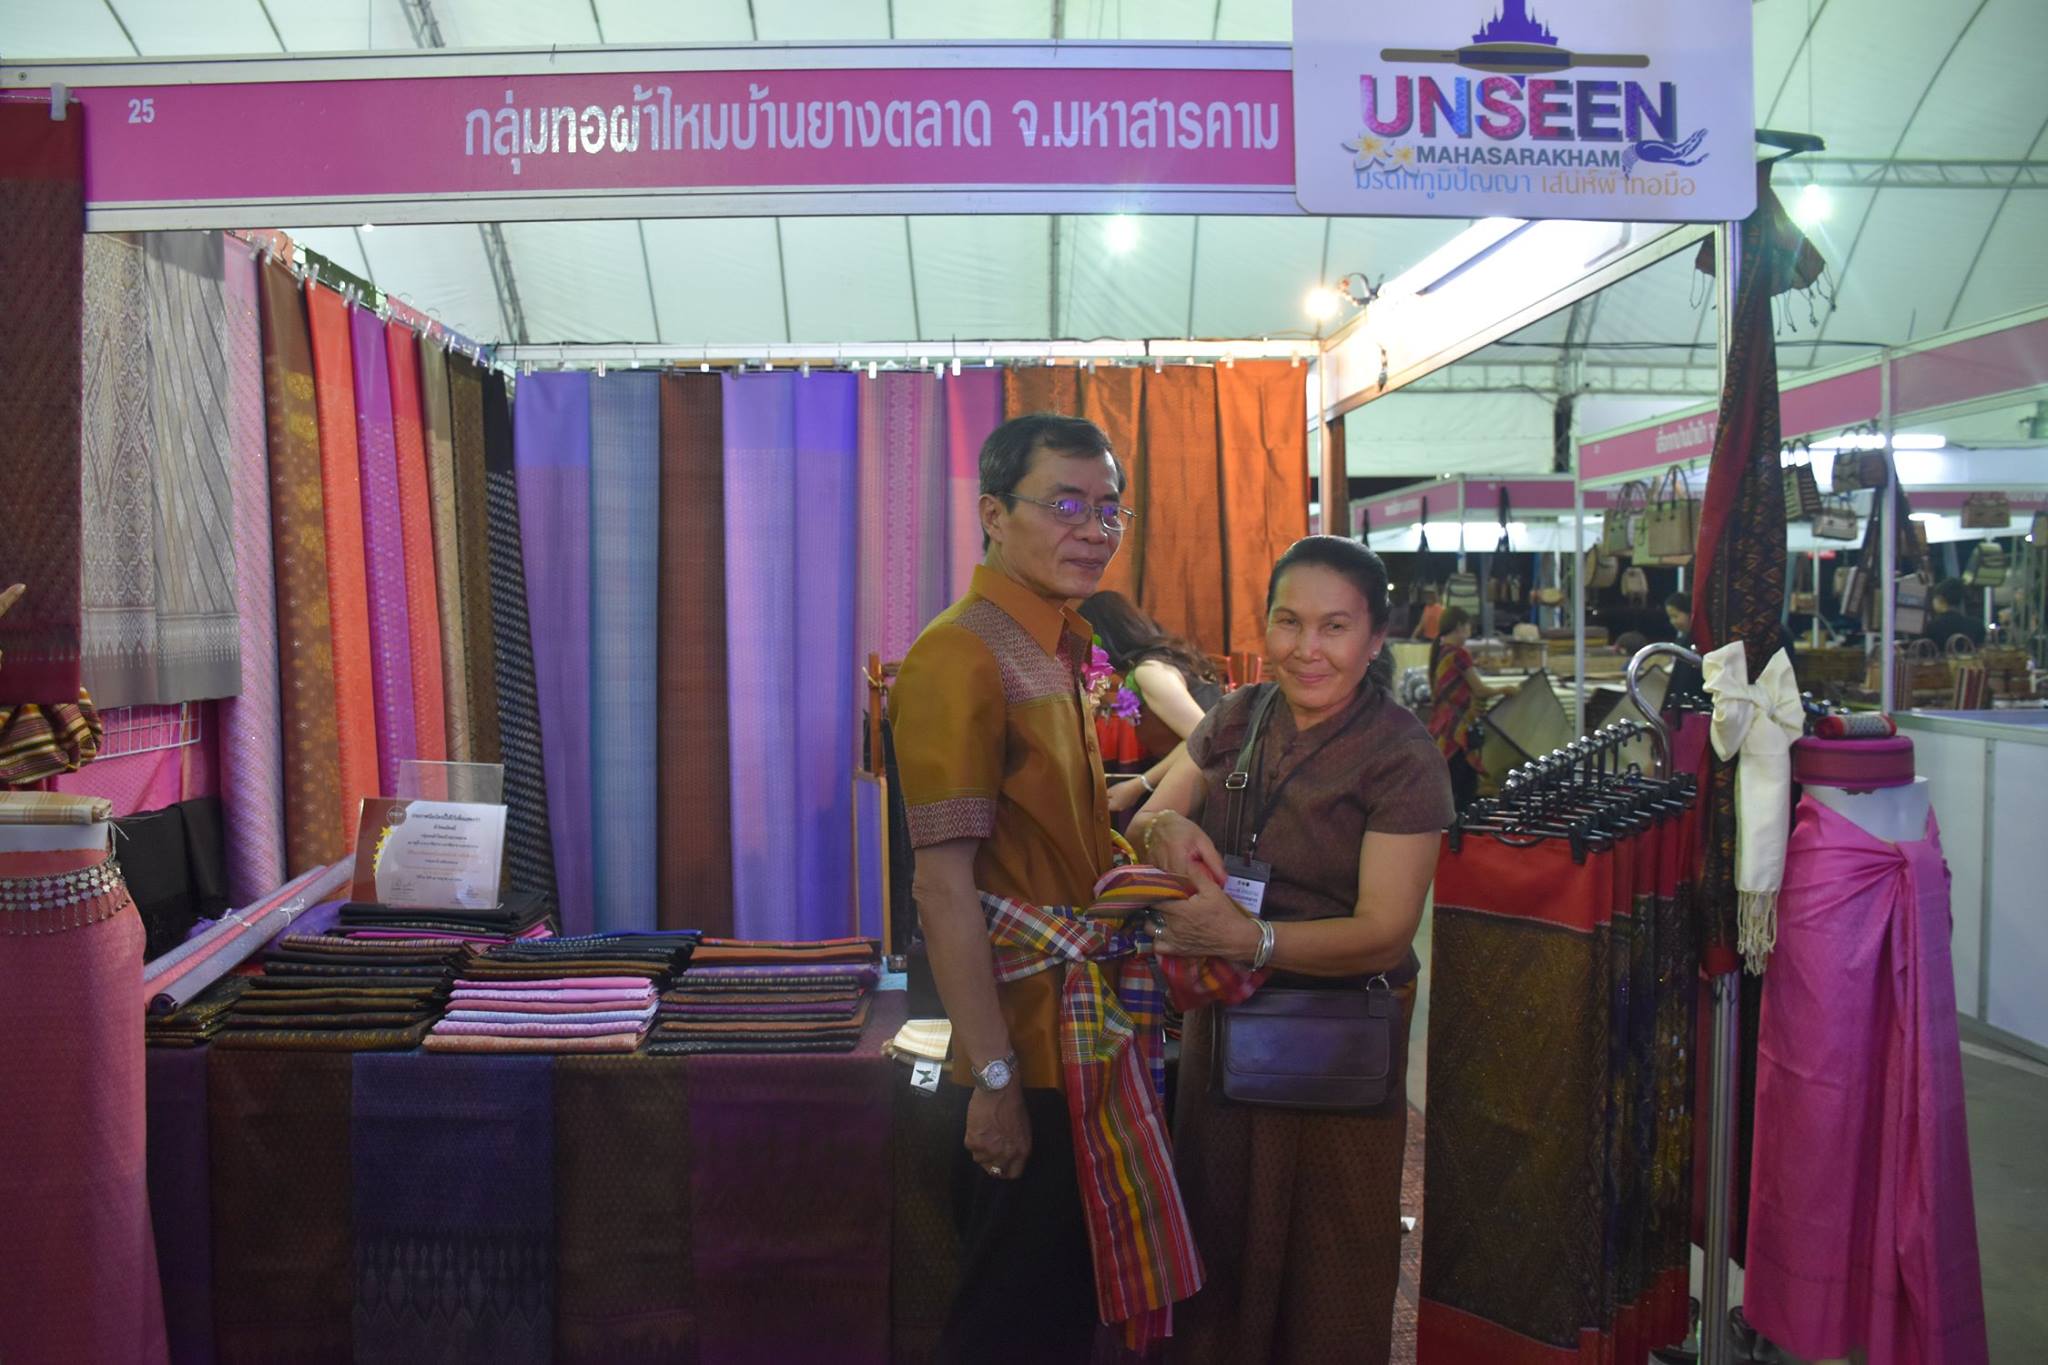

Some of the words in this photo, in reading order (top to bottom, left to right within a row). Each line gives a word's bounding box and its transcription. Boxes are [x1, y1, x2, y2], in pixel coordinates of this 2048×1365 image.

[127, 98, 156, 124] 25
[465, 83, 992, 175] กลุ่มทอผ้าไหมบ้านยางตลาด
[1012, 97, 1279, 150] จ.มหาสารคาม
[1359, 73, 1678, 143] UNSEEN
[1415, 145, 1621, 168] MAHASARAKHAM
